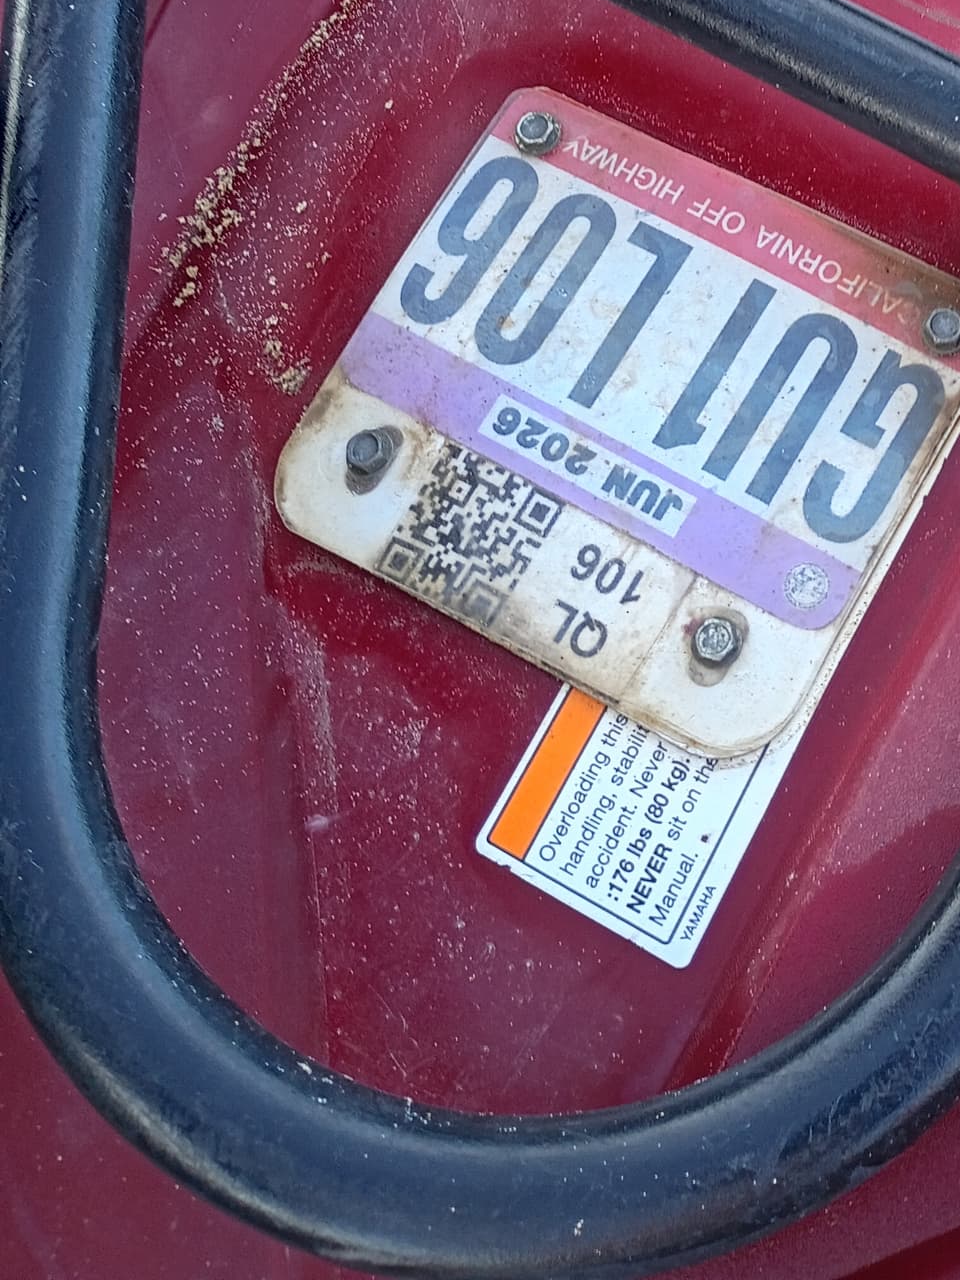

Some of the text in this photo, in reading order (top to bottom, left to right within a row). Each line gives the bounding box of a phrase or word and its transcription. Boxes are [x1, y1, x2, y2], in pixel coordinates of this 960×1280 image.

[562, 132, 919, 323] CALIFORNIA OFF HIGHWAY
[493, 407, 685, 521] JUN 2026
[571, 543, 644, 605] 106
[554, 599, 608, 659] QL
[536, 710, 629, 865] Overloading this
[560, 787, 618, 877] handling,
[582, 740, 670, 889] accident. Never
[626, 823, 653, 858] lbs
[643, 790, 672, 827] (80
[660, 751, 691, 793] kg).
[626, 841, 673, 913] NEVER
[664, 813, 686, 842] sit
[680, 786, 701, 814] on
[648, 847, 699, 927] Manual.
[679, 882, 717, 944] YAMAHA
